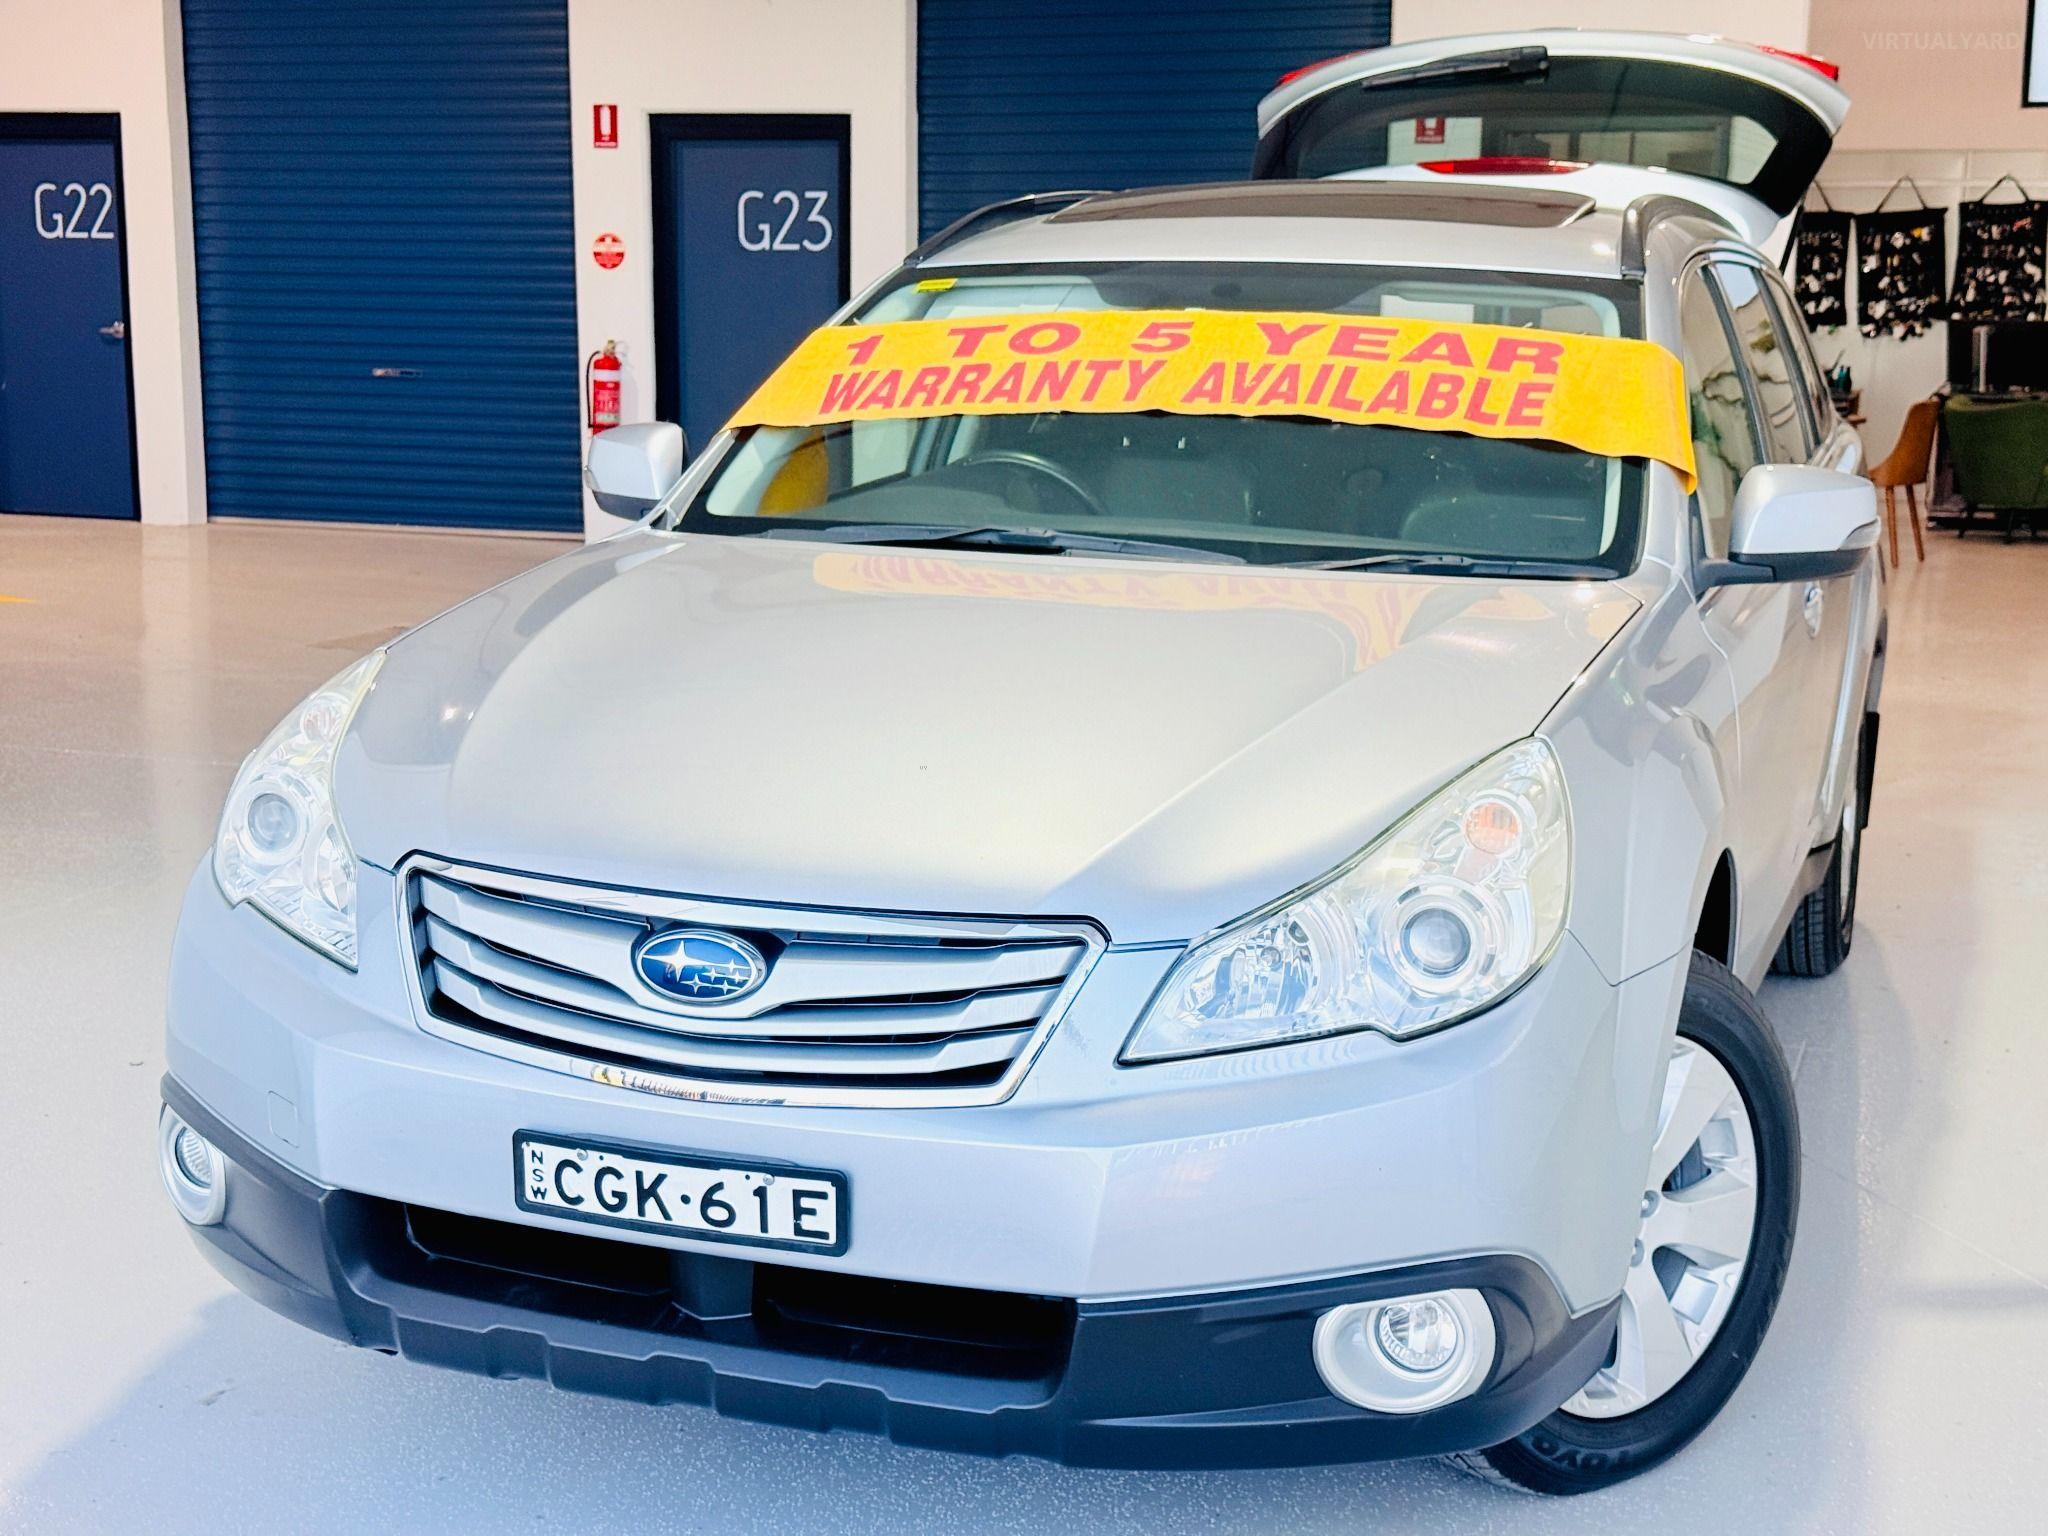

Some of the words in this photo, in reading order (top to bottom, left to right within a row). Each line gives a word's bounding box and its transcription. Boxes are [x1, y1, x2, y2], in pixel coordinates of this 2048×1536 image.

[34, 182, 115, 239] G22
[737, 190, 832, 252] G23
[847, 335, 884, 366] 1
[947, 322, 1081, 358] TO
[1131, 322, 1194, 354] 5
[1257, 322, 1564, 375] YEAR
[818, 360, 1168, 415] WARRANTY
[1180, 362, 1554, 426] AVAILABLE
